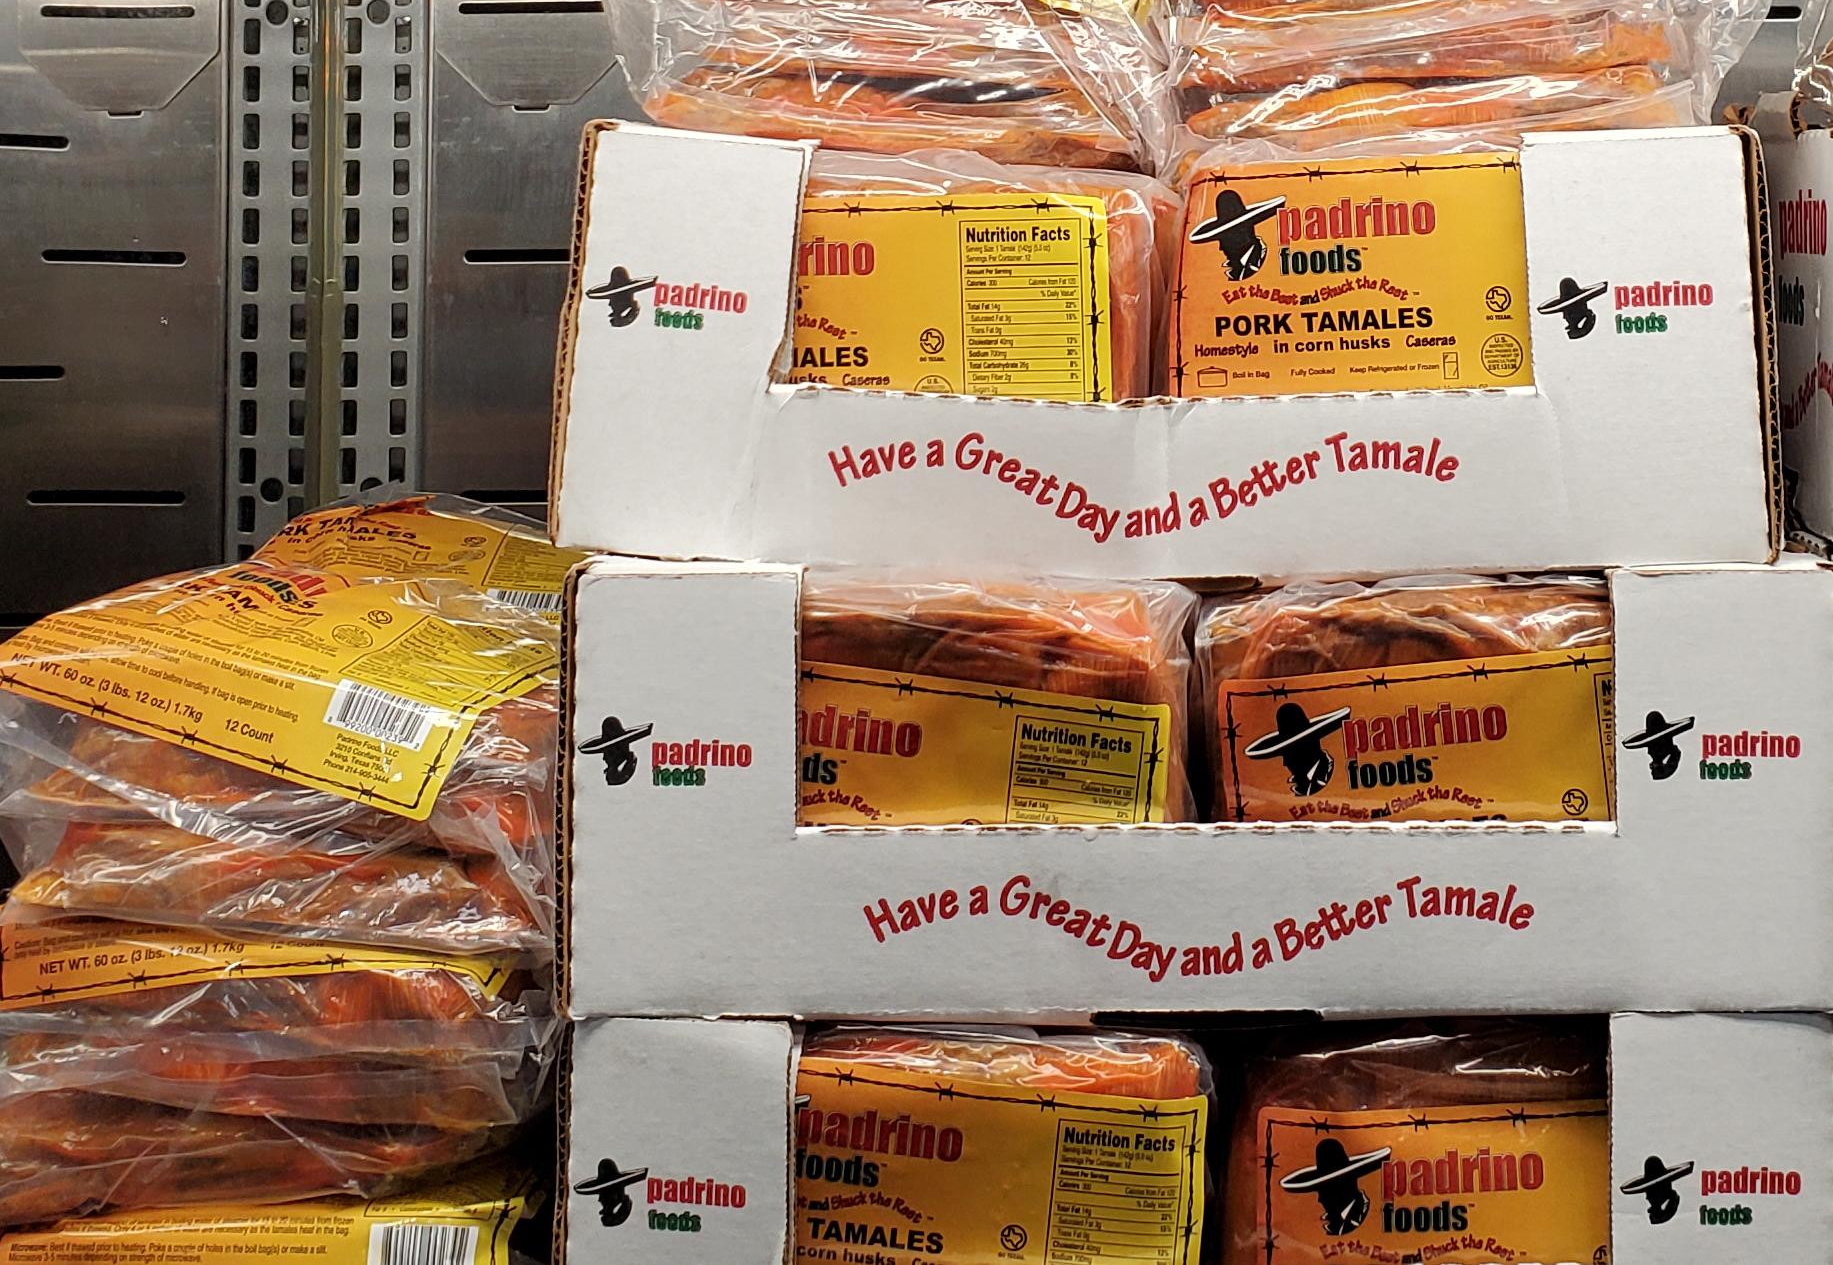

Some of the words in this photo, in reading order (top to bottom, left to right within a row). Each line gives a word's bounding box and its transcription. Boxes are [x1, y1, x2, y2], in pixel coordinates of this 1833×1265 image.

[965, 226, 1027, 243] Nutrition
[1031, 225, 1071, 242] Facts
[1277, 195, 1436, 246] padrino
[799, 236, 876, 276] rino
[1279, 244, 1363, 276] foods
[654, 282, 747, 314] padrino
[1248, 284, 1270, 300] the
[1299, 291, 1321, 306] and
[1319, 279, 1355, 303] Shuck
[1355, 276, 1378, 290] the
[1614, 280, 1713, 311] padrino
[654, 309, 703, 331] foods
[1215, 313, 1294, 337] PORK
[1300, 307, 1433, 333] TAMALES
[1614, 312, 1668, 335] foods
[793, 346, 869, 368] ALES
[1194, 342, 1259, 358] Homestyle
[1273, 339, 1289, 353] in
[1294, 340, 1334, 353] corn
[1339, 336, 1391, 351] husks
[1405, 334, 1456, 348] Caseras
[842, 373, 890, 387] Caseras
[1255, 370, 1270, 380] Bag
[1291, 367, 1307, 377] Fully
[1308, 367, 1336, 376] Cooked
[1417, 362, 1440, 371] Frozen
[828, 435, 917, 487] Have
[925, 438, 945, 468] a
[954, 431, 1060, 507] Great
[1055, 481, 1122, 544] Day
[1123, 491, 1181, 539] and
[1187, 496, 1211, 528] a
[1208, 450, 1321, 519] Better
[1324, 430, 1460, 483] Tamale
[38, 659, 60, 677] WT.
[63, 666, 80, 682] 60
[80, 674, 95, 689] oz.
[98, 676, 111, 693] (3
[111, 683, 131, 700] lbs.
[135, 689, 149, 705] 12
[150, 695, 172, 714] oz.)
[173, 701, 204, 724] 1.7kg
[225, 717, 240, 733] 12
[240, 723, 275, 744] Count
[800, 703, 923, 758] drino
[1021, 723, 1087, 748] Nutrition
[1090, 732, 1132, 754] Facts
[1342, 702, 1508, 758] padrino
[1701, 730, 1801, 761] padrino
[652, 738, 753, 769] padrino
[652, 765, 706, 788] foods
[1347, 752, 1434, 790] foods
[1699, 758, 1752, 781] foods
[1370, 801, 1391, 819] and
[863, 882, 960, 943] Have
[968, 885, 989, 915] a
[999, 875, 1111, 949] Great
[1106, 920, 1177, 983] Day
[1180, 932, 1246, 977] and
[1251, 936, 1274, 970] a
[1273, 891, 1395, 961] Better
[1396, 874, 1535, 931] Tamale
[40, 959, 65, 976] NET
[68, 954, 91, 974] WT.
[94, 952, 110, 968] 60
[131, 948, 143, 965] (3
[144, 947, 167, 962] lbs.
[212, 940, 245, 955] 1.7kg
[797, 1108, 964, 1163] padrino
[1063, 1126, 1130, 1150] Nutrition
[1134, 1132, 1175, 1153] Facts
[1381, 1145, 1544, 1201] padrino
[1700, 1166, 1802, 1198] padrino
[647, 1175, 746, 1209] padrino
[648, 1207, 702, 1233] foods
[1382, 1200, 1469, 1234] foods
[1699, 1202, 1753, 1226] foods
[806, 1216, 945, 1255] TAMALES
[842, 1247, 896, 1265] husks
[1401, 1247, 1423, 1263] and
